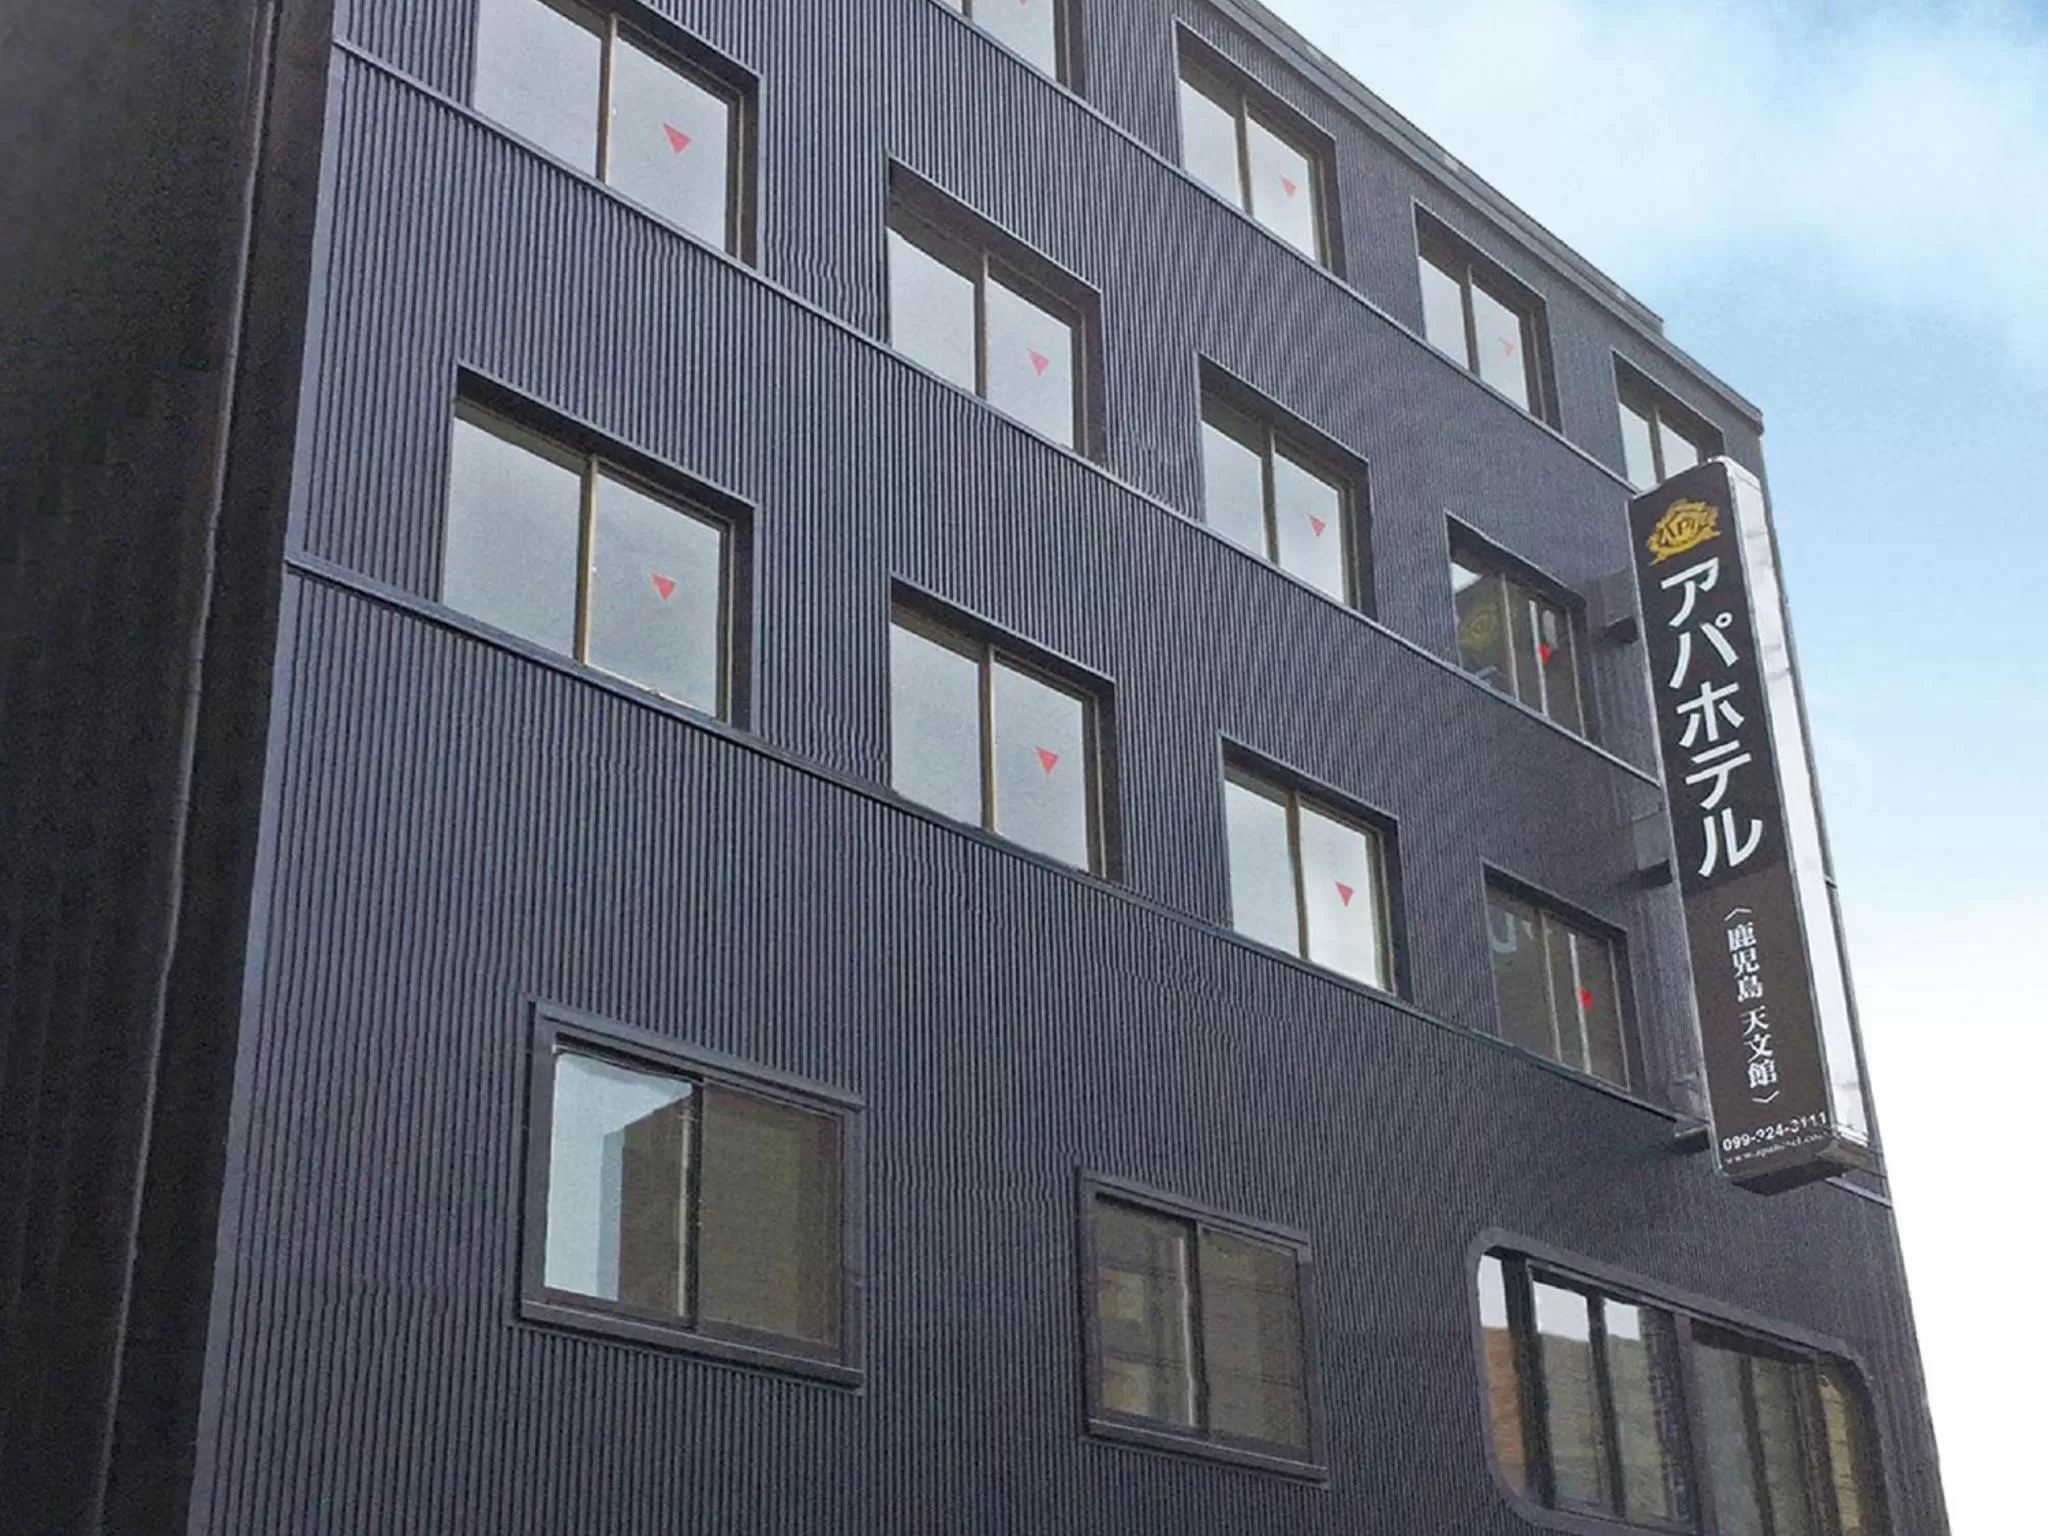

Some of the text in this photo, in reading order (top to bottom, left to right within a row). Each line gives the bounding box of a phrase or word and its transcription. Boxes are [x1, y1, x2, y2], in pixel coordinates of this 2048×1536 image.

[1660, 556, 1763, 878] アパホテル
